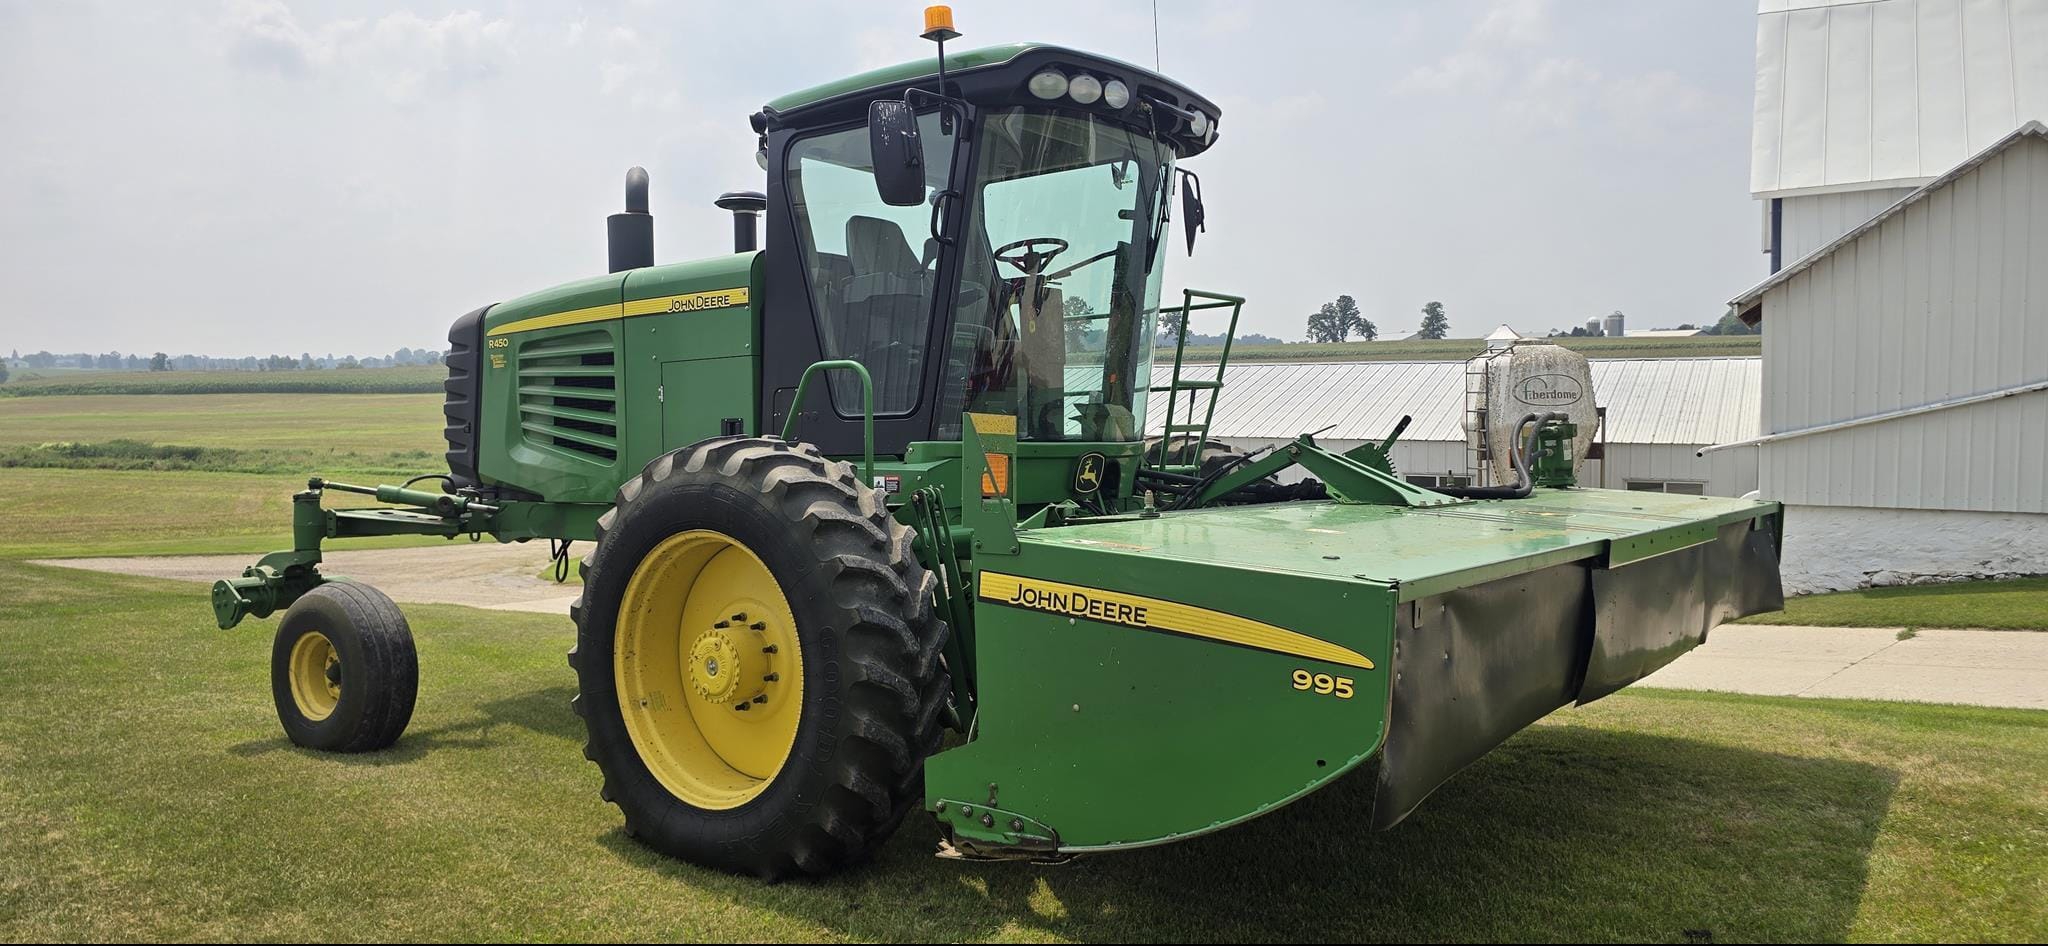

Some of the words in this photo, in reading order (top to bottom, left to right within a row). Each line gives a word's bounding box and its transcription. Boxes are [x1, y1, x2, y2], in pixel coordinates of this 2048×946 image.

[668, 298, 695, 312] JOHN
[696, 294, 730, 309] DEERE
[488, 338, 509, 349] R450
[1010, 583, 1068, 611] JOHN
[1071, 592, 1148, 625] DEERE
[1292, 668, 1354, 699] 995
